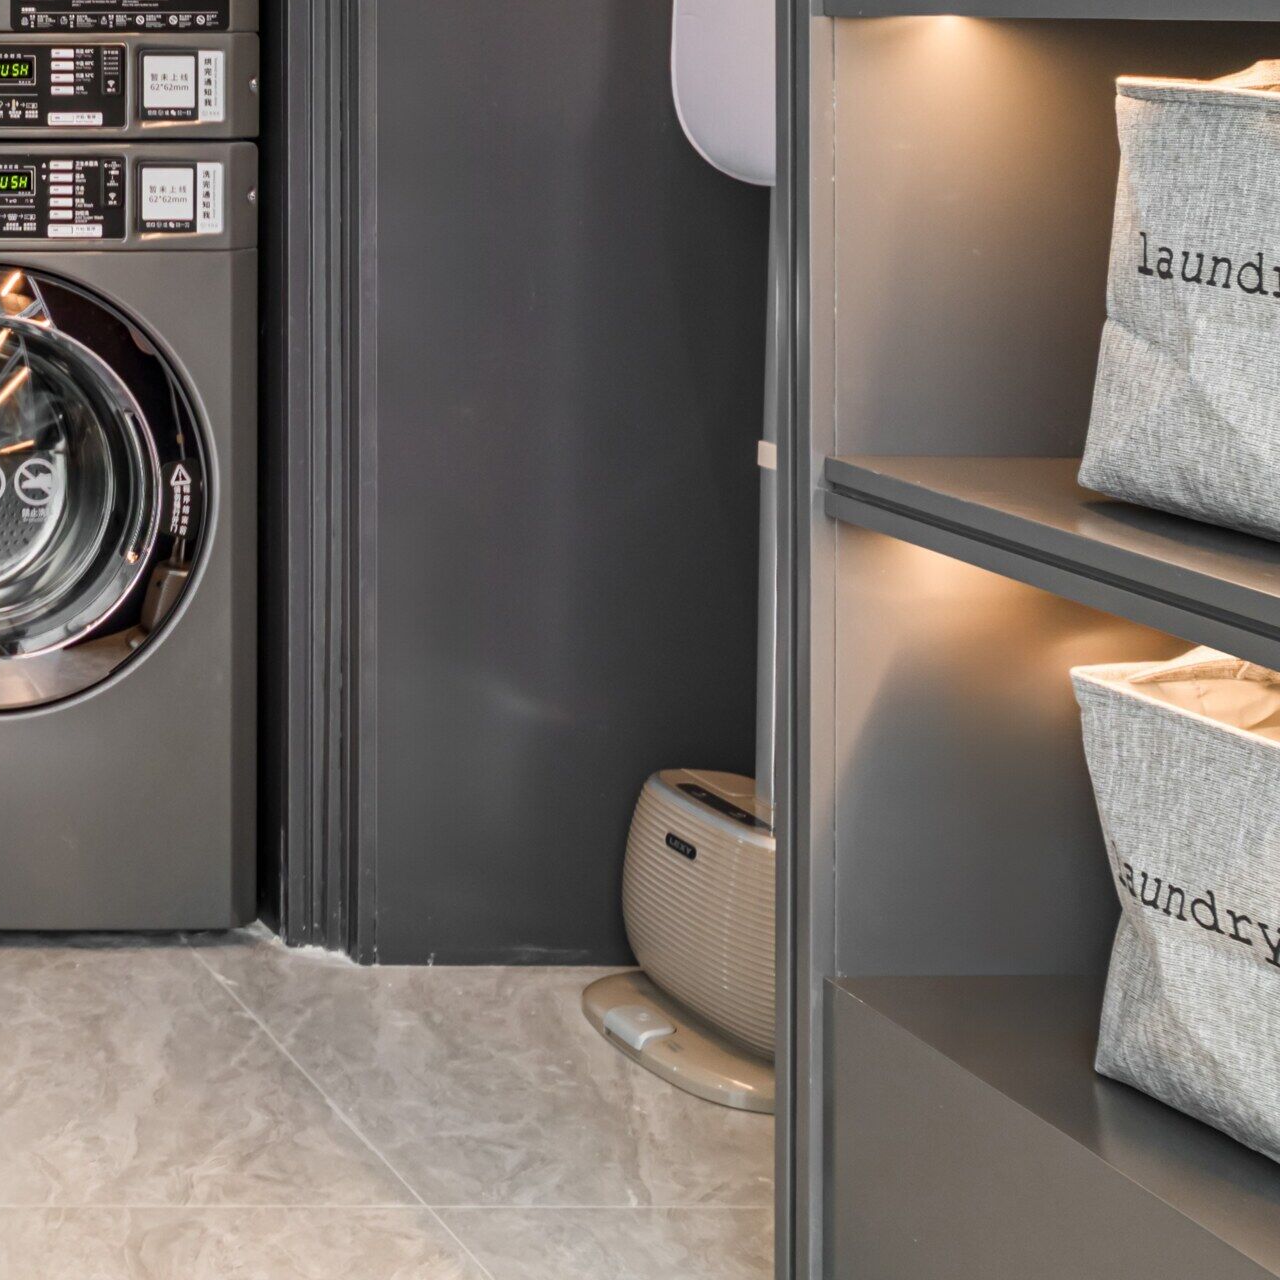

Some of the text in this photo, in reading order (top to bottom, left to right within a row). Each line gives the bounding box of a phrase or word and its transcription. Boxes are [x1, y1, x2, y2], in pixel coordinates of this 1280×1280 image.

[150, 73, 188, 81] 暂未上线
[149, 185, 187, 193] 暂未上线
